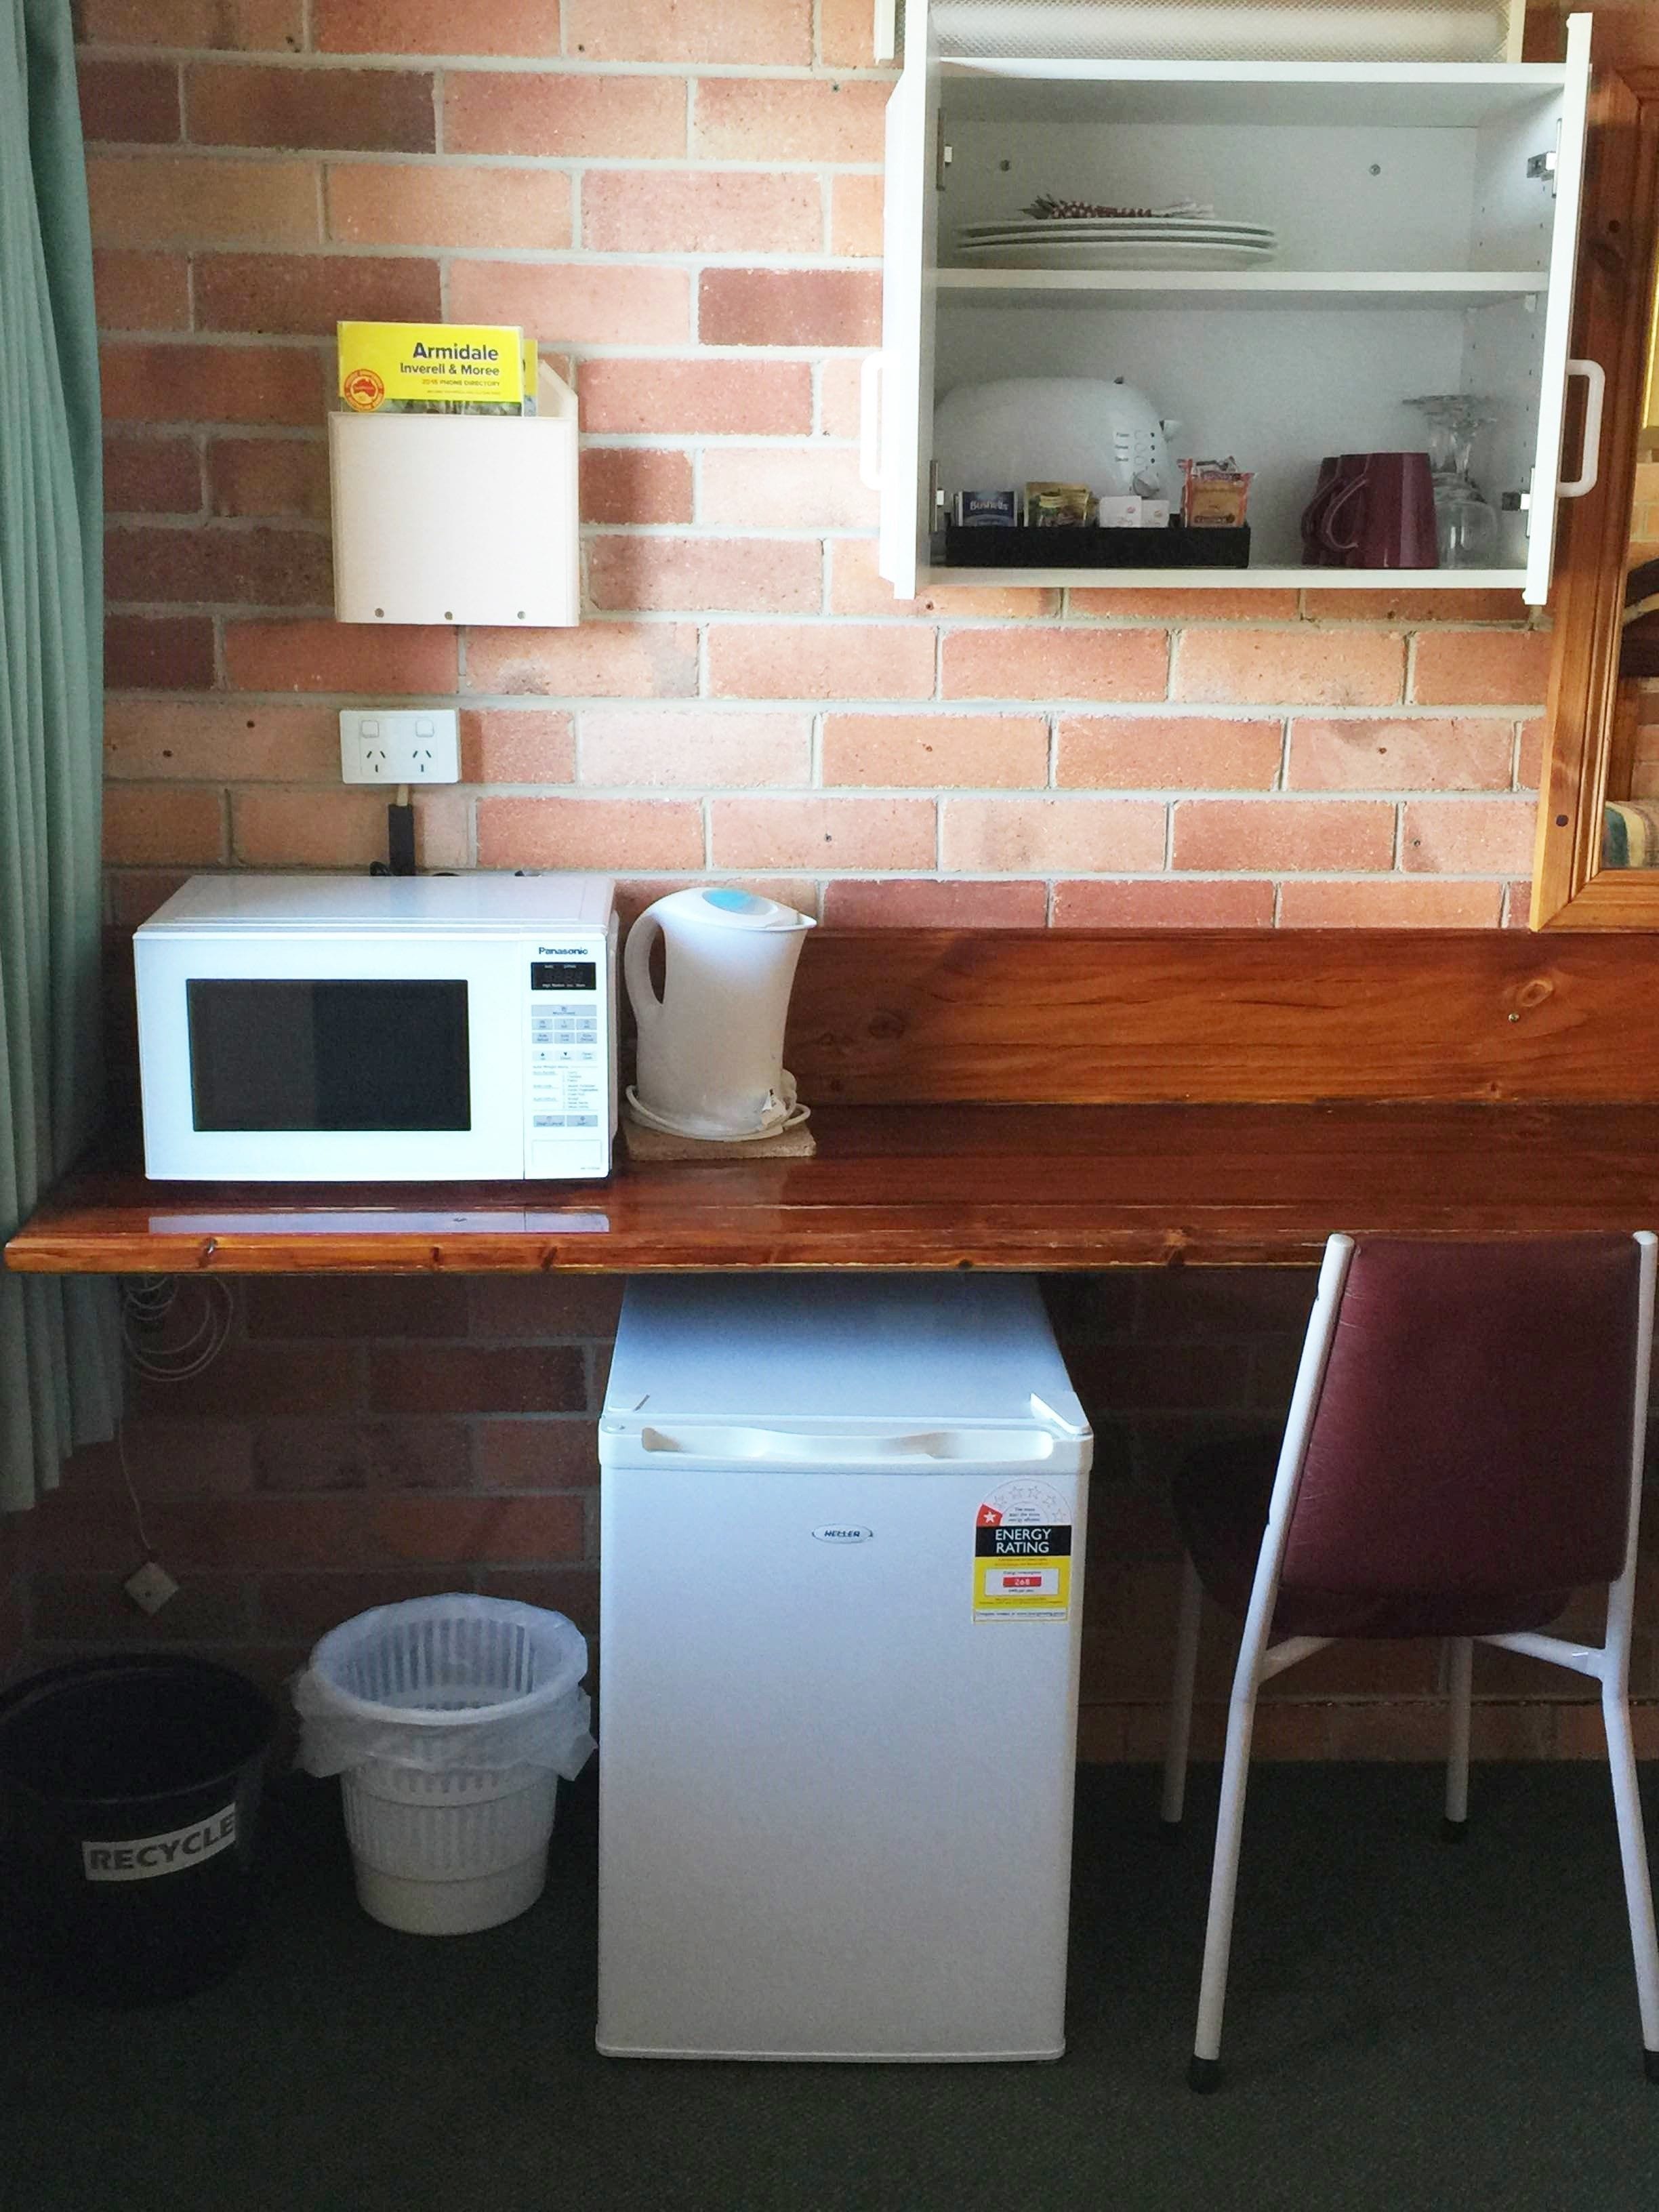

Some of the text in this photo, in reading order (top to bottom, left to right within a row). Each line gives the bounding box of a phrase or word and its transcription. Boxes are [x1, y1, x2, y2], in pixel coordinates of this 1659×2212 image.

[413, 342, 499, 361] Armidale
[401, 363, 500, 376] Inverell & Moree
[995, 1528, 1051, 1540] ENERGY
[996, 1542, 1050, 1553] RATING
[89, 1813, 234, 1870] RECYCLE
